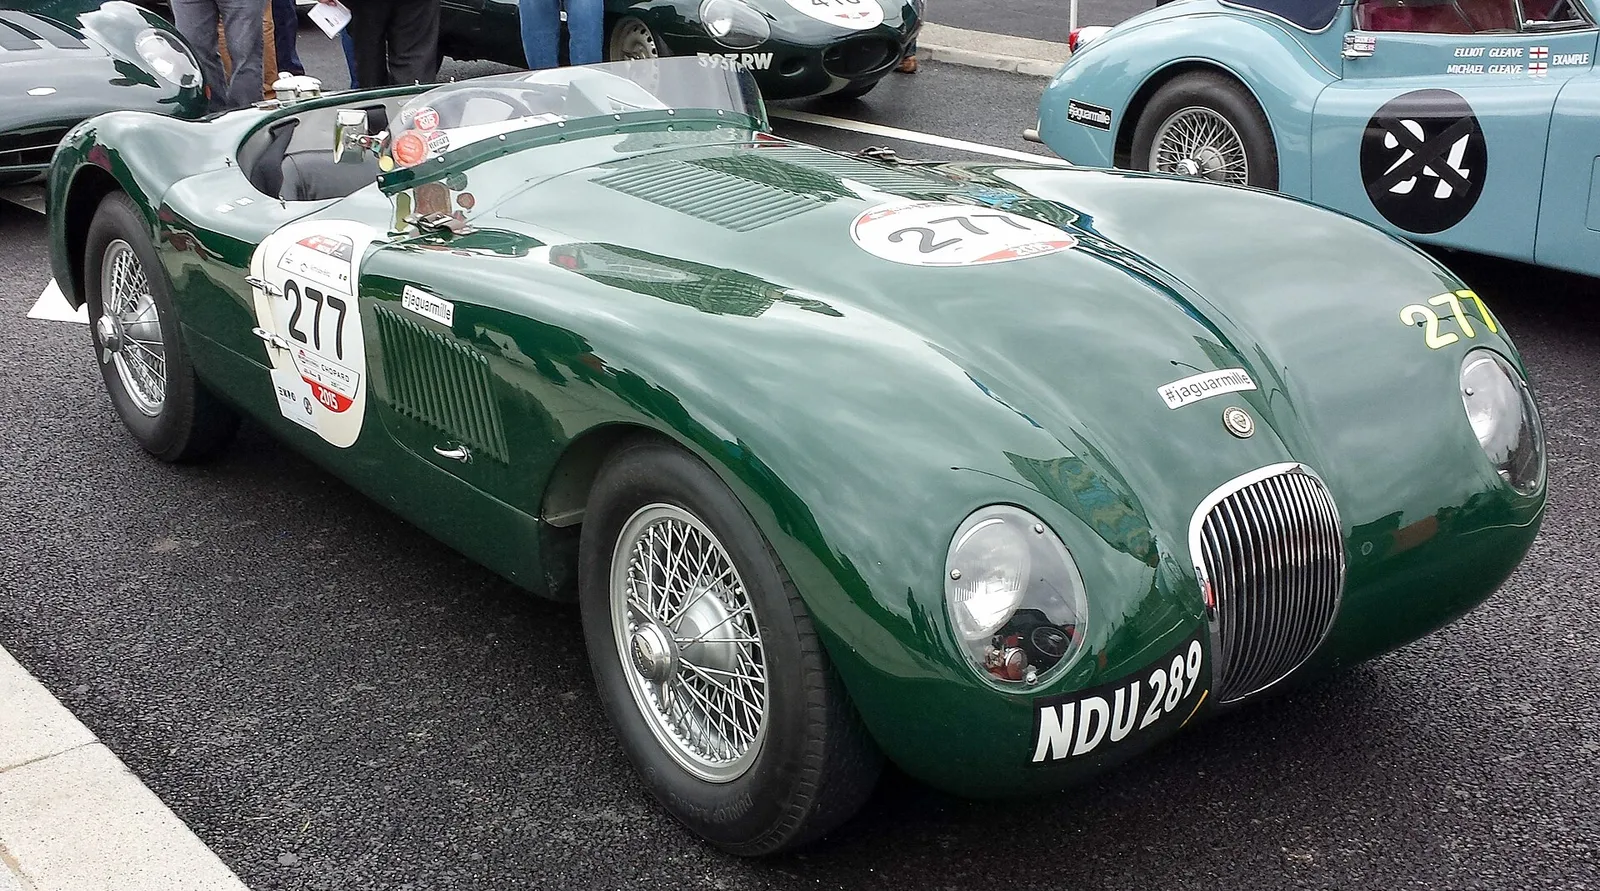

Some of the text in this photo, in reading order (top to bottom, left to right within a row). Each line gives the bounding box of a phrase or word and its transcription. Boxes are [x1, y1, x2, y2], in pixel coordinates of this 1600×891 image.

[1454, 48, 1524, 58] ELLIOT GLEAVE
[1552, 54, 1589, 65] EXAMPLE
[1447, 64, 1523, 74] MICHAEL GLEAVE
[1068, 102, 1111, 125] #jaguarmille
[888, 214, 1031, 254] 277
[404, 289, 452, 321] #jaguarmille
[284, 279, 347, 361] 277
[1399, 289, 1499, 350] 277
[321, 363, 350, 383] CHOPARD
[318, 386, 339, 411] 2015
[1165, 372, 1251, 403] #jaguarmille
[1032, 639, 1203, 763] NDU 289
